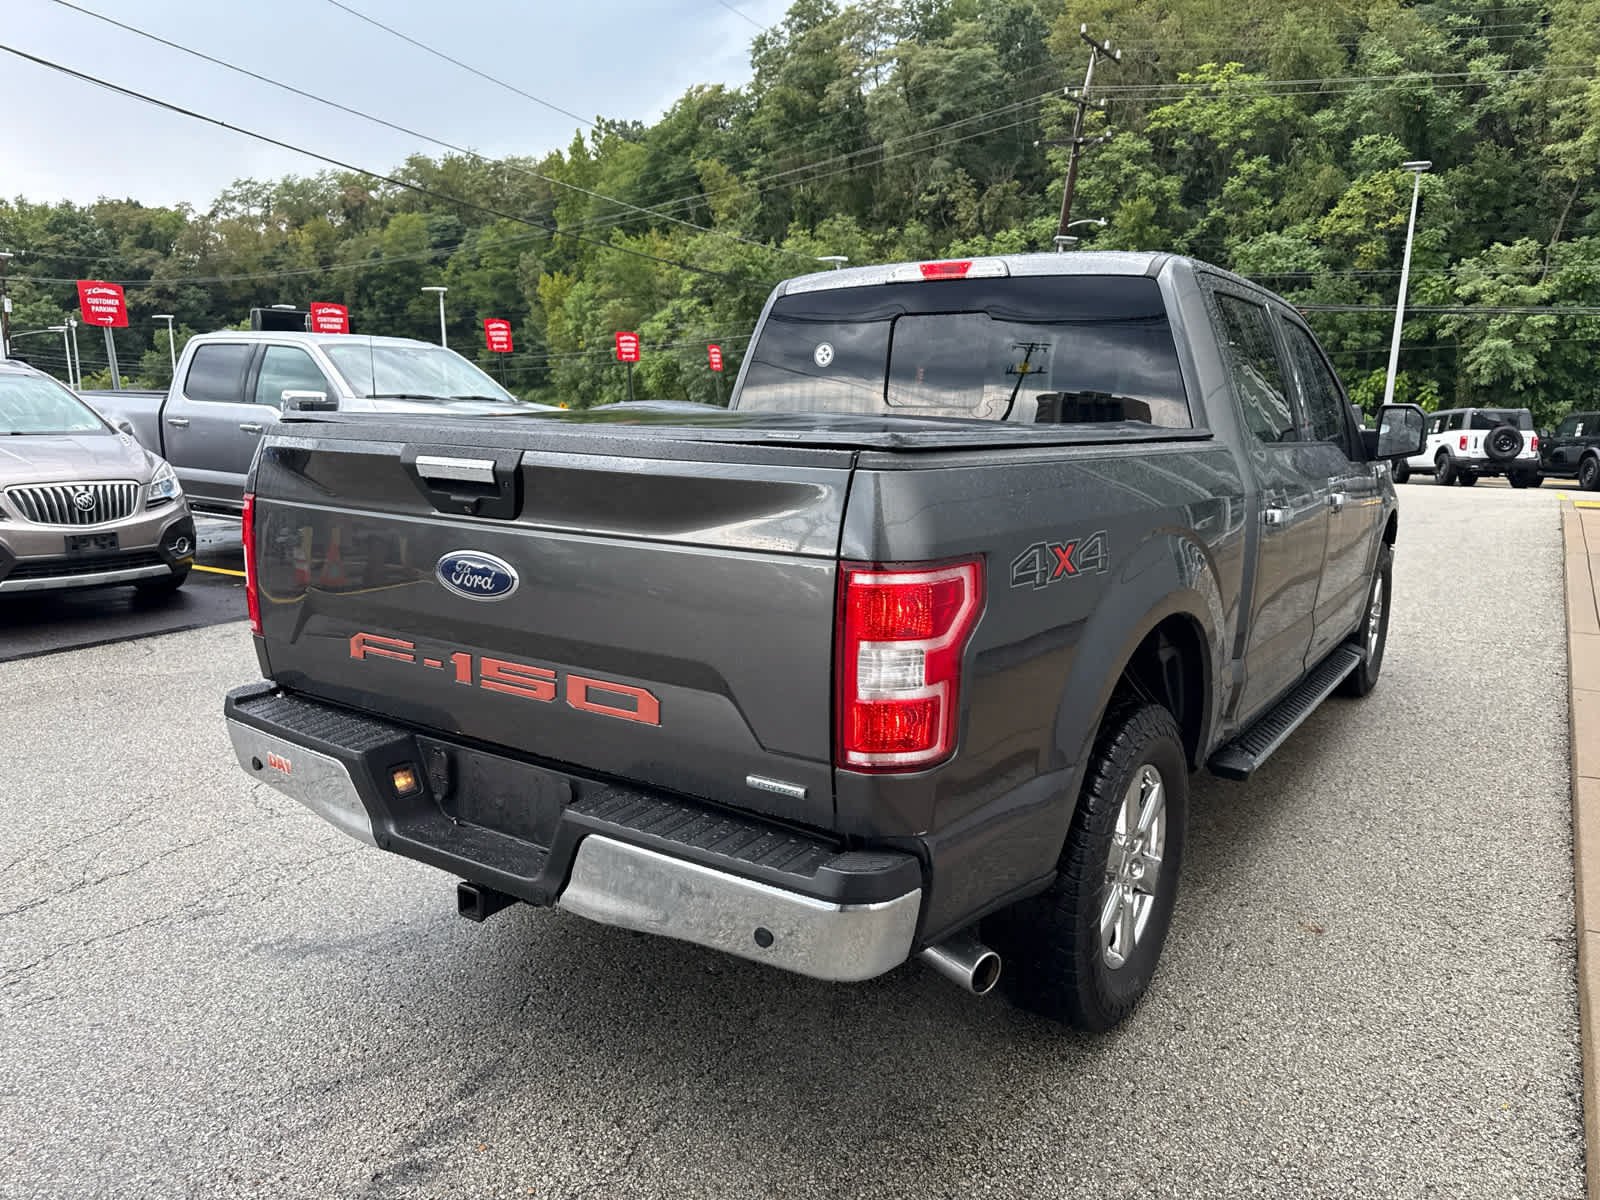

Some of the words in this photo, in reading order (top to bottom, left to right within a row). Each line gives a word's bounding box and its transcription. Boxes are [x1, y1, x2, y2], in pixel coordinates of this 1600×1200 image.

[86, 297, 120, 306] CUSTOMER
[91, 305, 118, 313] PARKING
[451, 560, 495, 592] Ford
[350, 632, 662, 727] F-150
